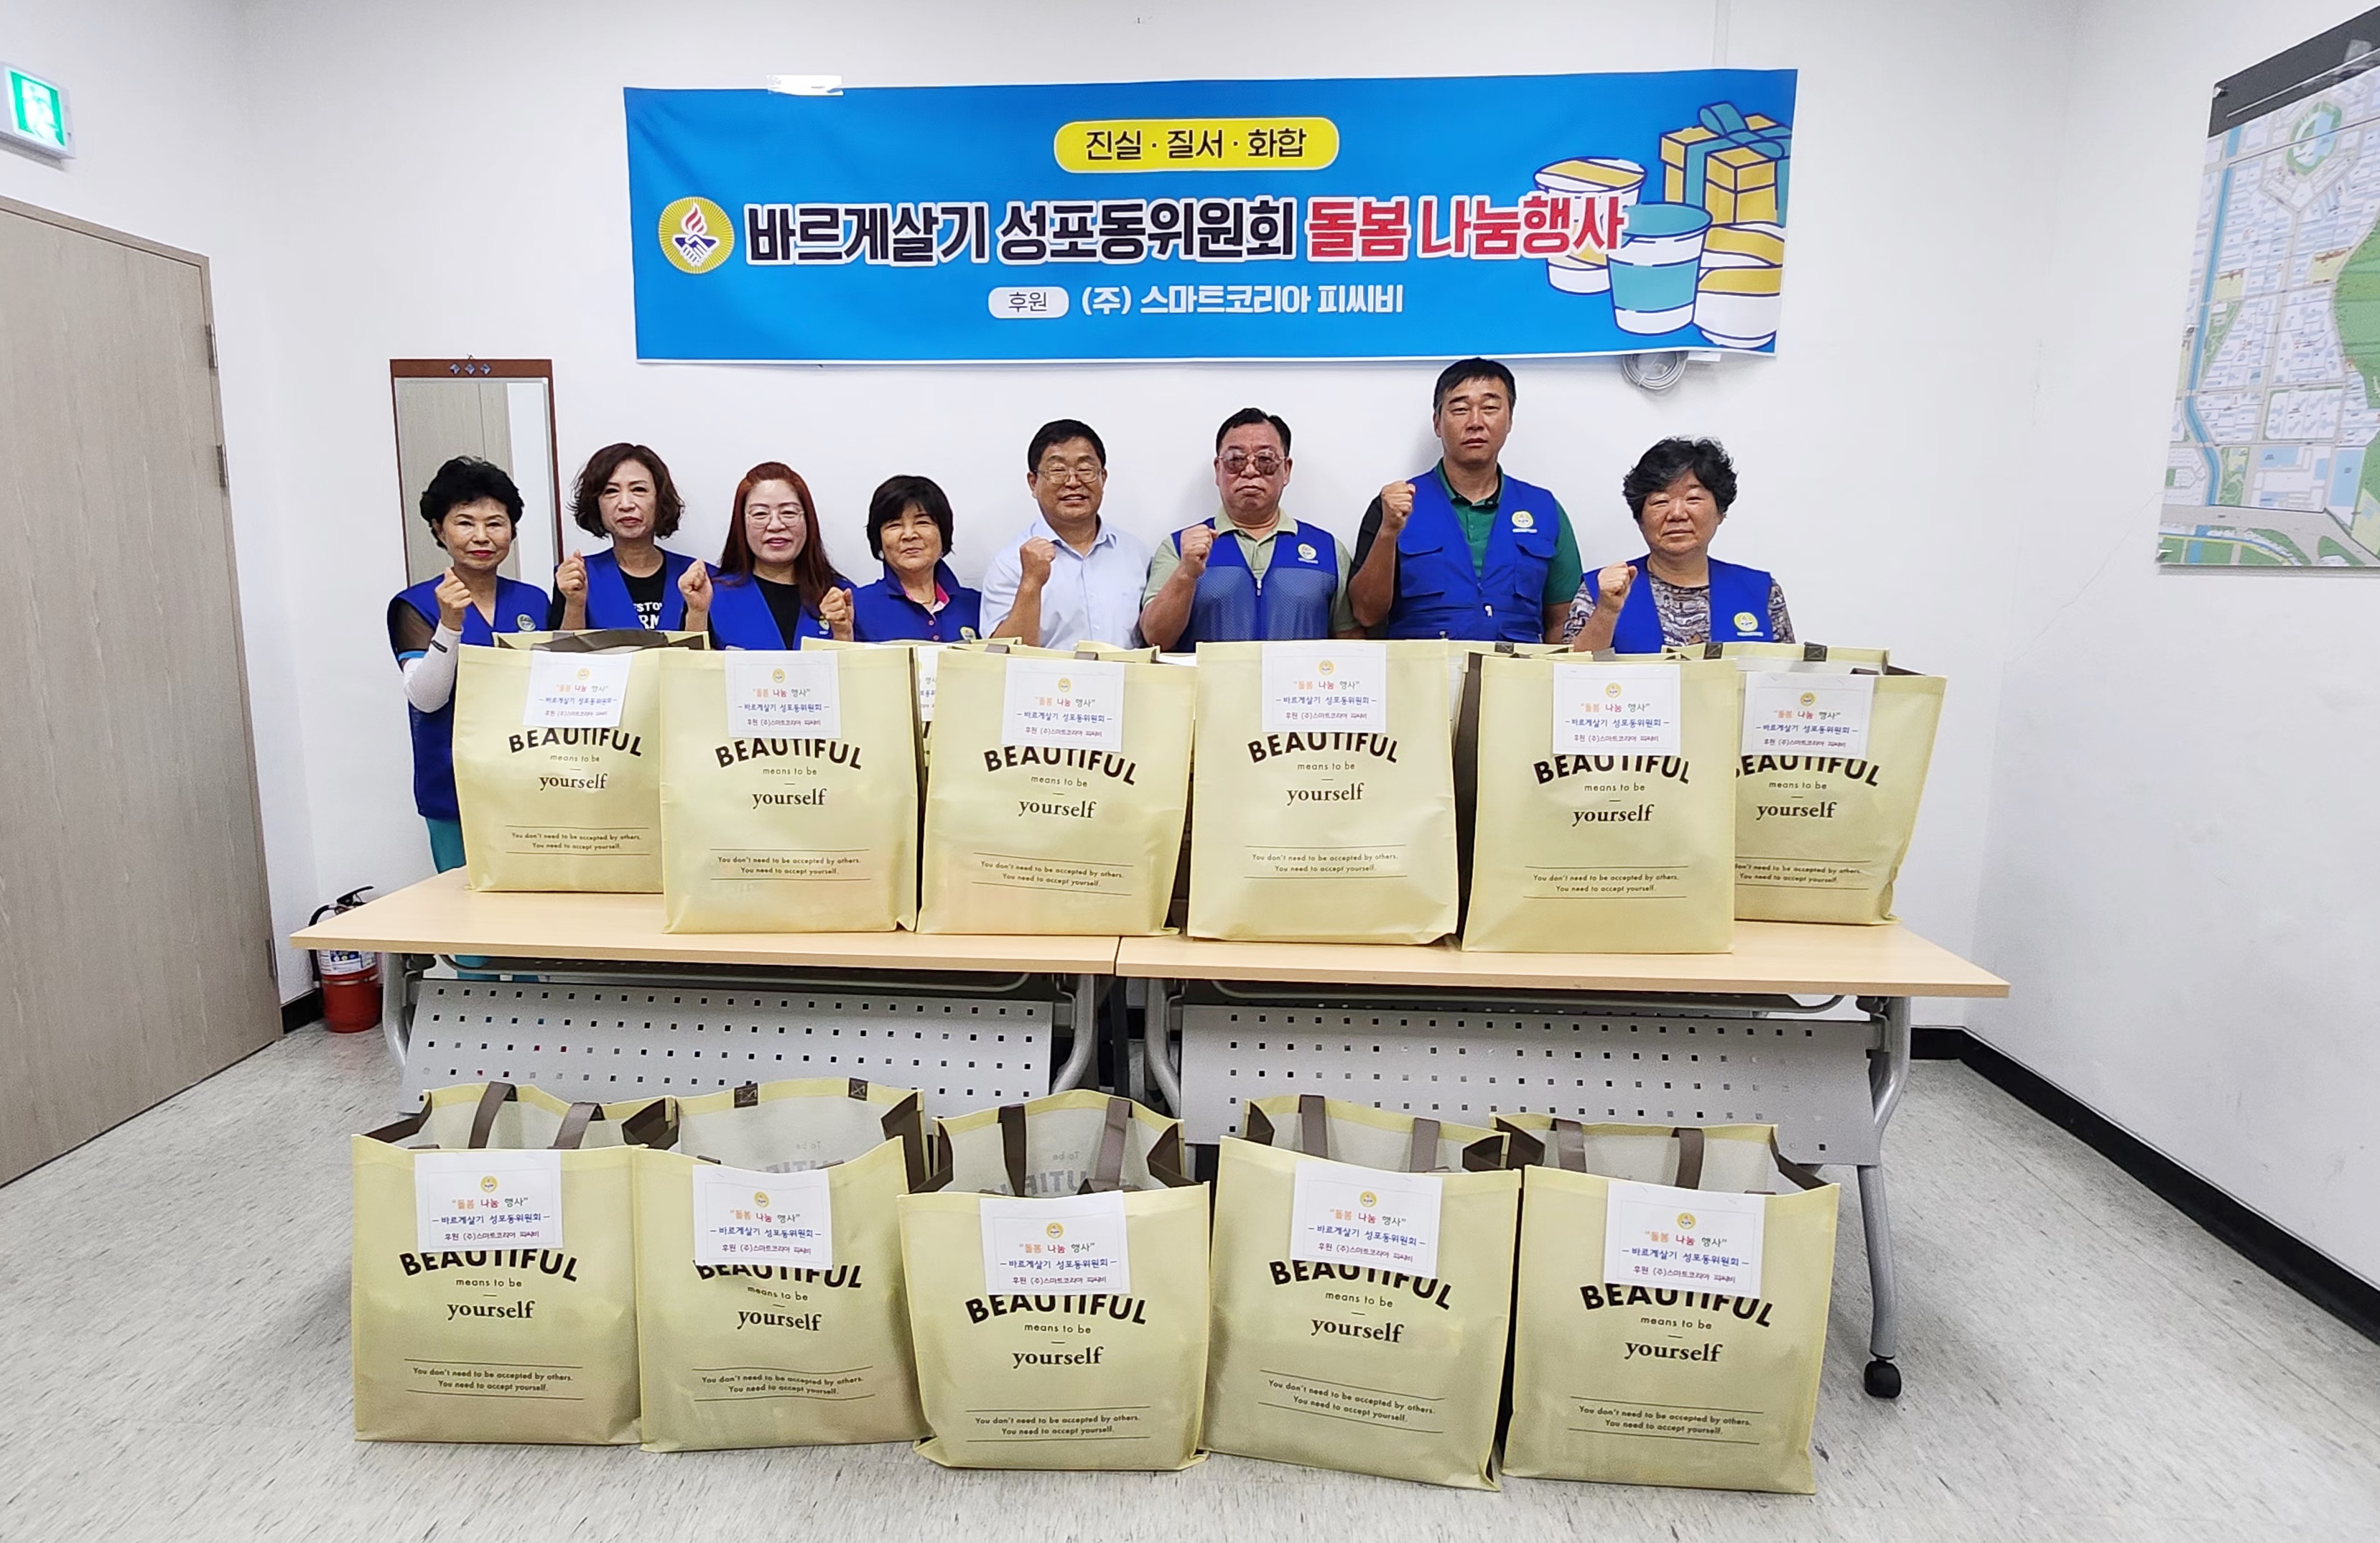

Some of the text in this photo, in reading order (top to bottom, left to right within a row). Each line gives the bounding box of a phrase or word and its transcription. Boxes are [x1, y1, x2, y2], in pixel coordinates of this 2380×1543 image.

[1085, 128, 1307, 161] 진실 질서 화합
[745, 195, 1628, 265] 바르게살기 성포동위원회 돌봄 나눔행사
[1008, 283, 1404, 317] 후원 (주) 스마트코리아 피씨비
[508, 727, 642, 757] BEAUTIFUL
[1247, 732, 1398, 763] BEAUTIFUL
[591, 754, 600, 763] be
[715, 737, 862, 770] BEAUTIFUL
[806, 765, 817, 775] be
[984, 745, 1136, 786] BEAUTIFUL
[1344, 760, 1355, 770] be
[1533, 754, 1689, 785] BEAUTIFUL
[1741, 754, 1879, 787] EAUTIFUL
[538, 773, 608, 791] yourself
[1031, 776, 1088, 788] means to be
[1620, 783, 1630, 792] to
[1633, 781, 1645, 791] be
[1814, 780, 1828, 790] be
[751, 788, 828, 810] yourself
[1286, 782, 1365, 807] yourself
[1018, 800, 1097, 819] yourself
[1571, 803, 1655, 828] yourself
[1755, 801, 1838, 821] yourself
[493, 1279, 505, 1287] to
[508, 1277, 522, 1287] be
[747, 1286, 778, 1298] means
[794, 1290, 809, 1301] be
[1324, 1292, 1393, 1308] means to be
[446, 1300, 536, 1321] yourself
[964, 1294, 1146, 1325] BEAUTIFUL
[736, 1310, 822, 1332] yourself
[1024, 1323, 1092, 1334] means to be
[1310, 1318, 1405, 1344] yourself
[1640, 1317, 1712, 1330] means to be
[1011, 1346, 1105, 1370] yourself
[1624, 1342, 1724, 1363] yourself
[1268, 1379, 1283, 1389] You
[1285, 1382, 1307, 1393] don't
[1308, 1388, 1329, 1397] need
[1342, 1392, 1352, 1401] be
[1394, 1400, 1405, 1412] by
[1293, 1395, 1308, 1405] You
[1310, 1400, 1331, 1409] need
